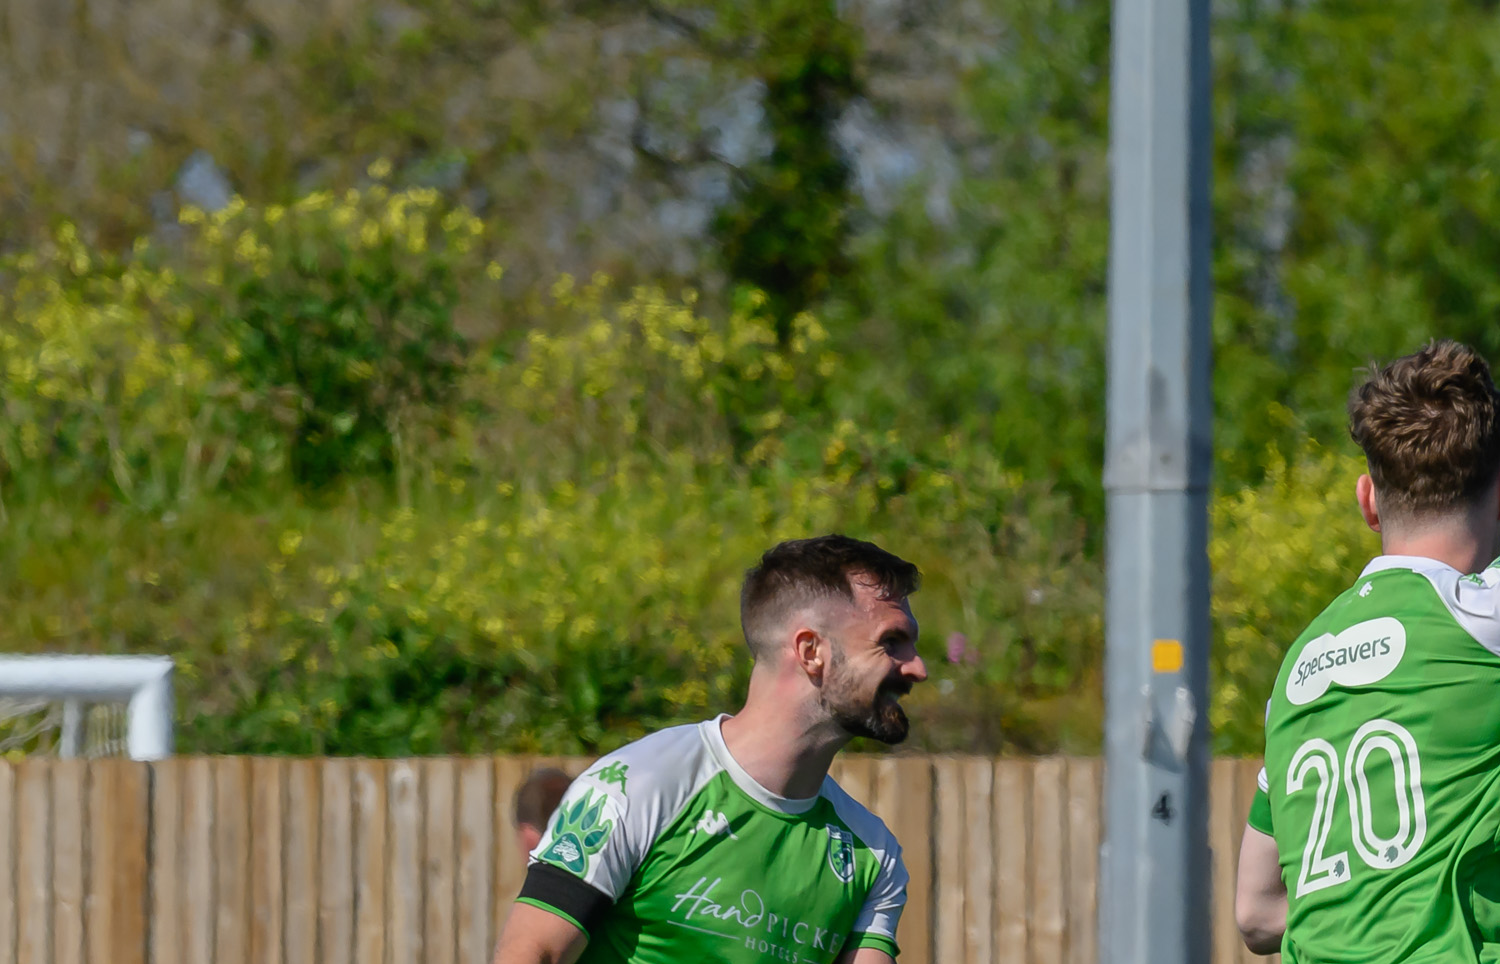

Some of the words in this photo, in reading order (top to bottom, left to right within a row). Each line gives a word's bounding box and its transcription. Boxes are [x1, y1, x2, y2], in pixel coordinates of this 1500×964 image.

[1296, 636, 1392, 686] Specsavers
[1286, 718, 1427, 900] 20
[745, 936, 798, 964] HOTELS
